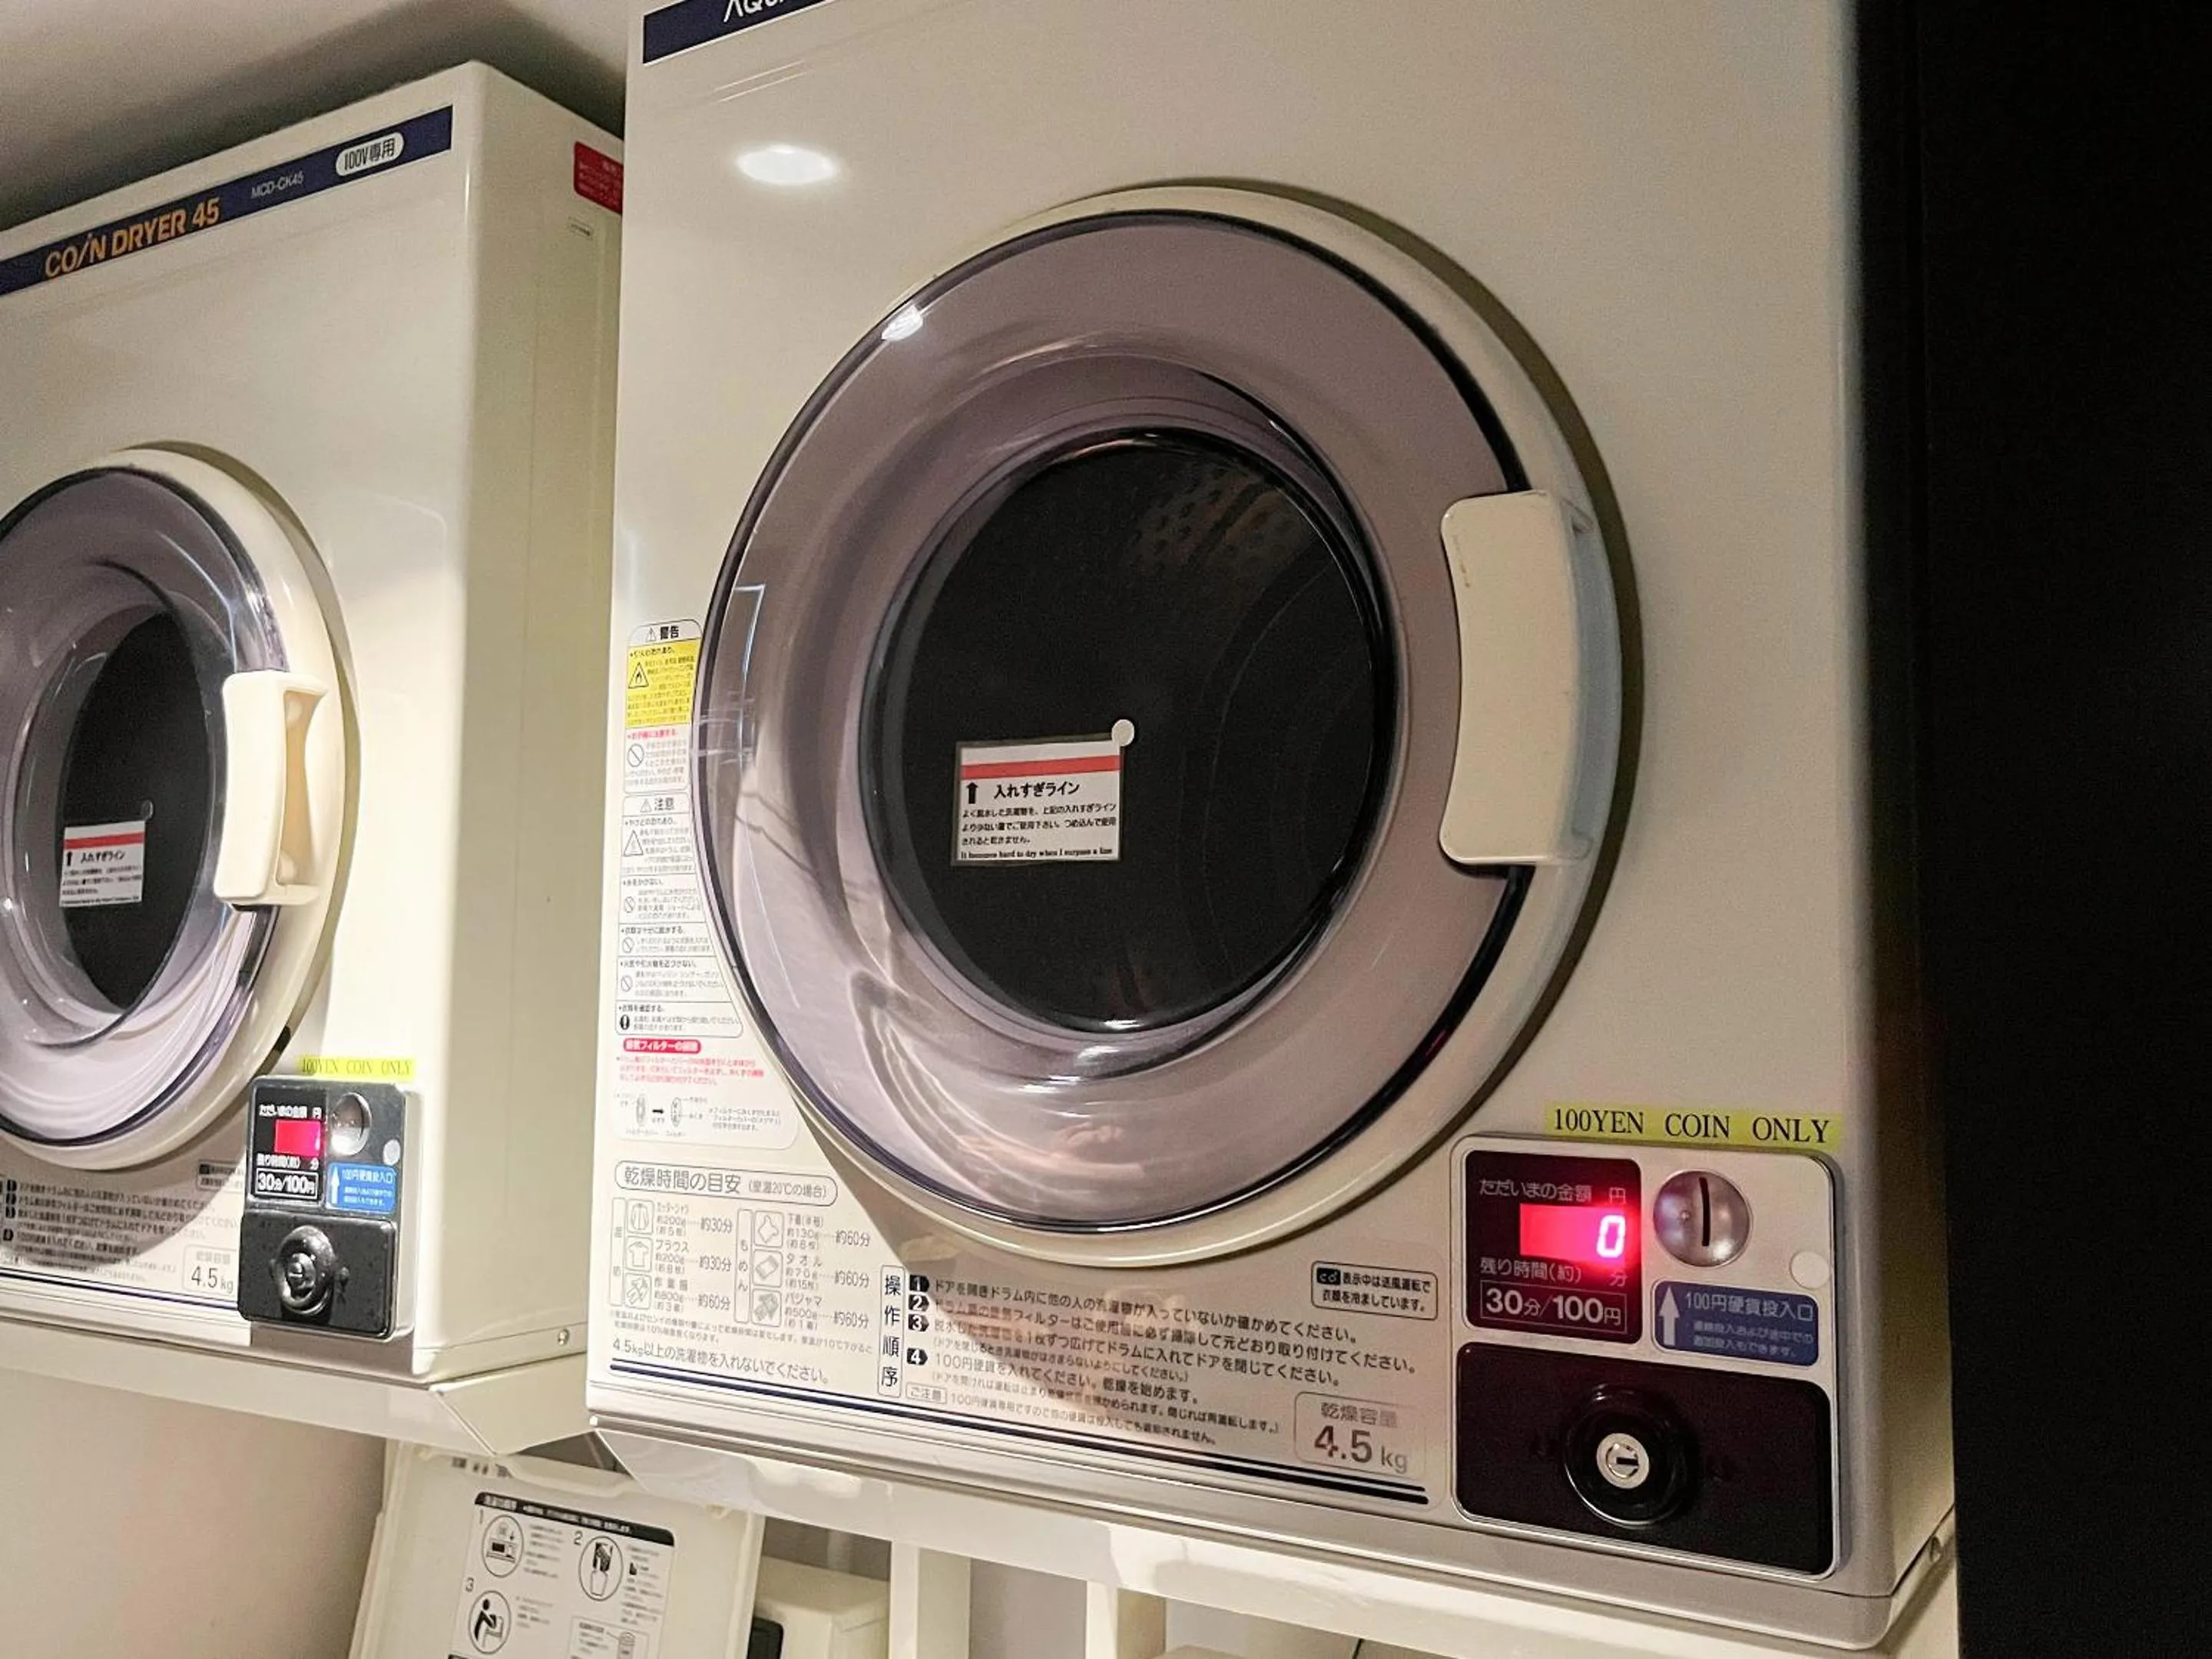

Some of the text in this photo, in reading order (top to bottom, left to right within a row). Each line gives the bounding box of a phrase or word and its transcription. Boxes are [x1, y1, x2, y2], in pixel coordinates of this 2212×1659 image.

[111, 209, 186, 256] DRYER
[192, 197, 220, 227] 45
[993, 781, 1081, 799] 入れすぎライン
[1555, 1108, 1830, 1143] 100YEN COIN ONLY
[624, 1166, 741, 1194] 乾燥時間の目安
[1479, 1179, 1626, 1204] ただいまの金額 円
[1596, 1214, 1626, 1259] 0
[190, 1266, 218, 1289] 4.5
[1480, 1257, 1582, 1283] 残り時間(約)
[912, 1295, 922, 1311] 2
[1485, 1287, 1622, 1326] 30分/100円
[1685, 1292, 1814, 1322] 100円硬貨投入口
[912, 1315, 922, 1332] 3
[910, 1349, 921, 1365] 4
[1314, 1425, 1409, 1474] 4.5 kg
[573, 1530, 584, 1546] 2
[465, 1577, 475, 1593] 3
